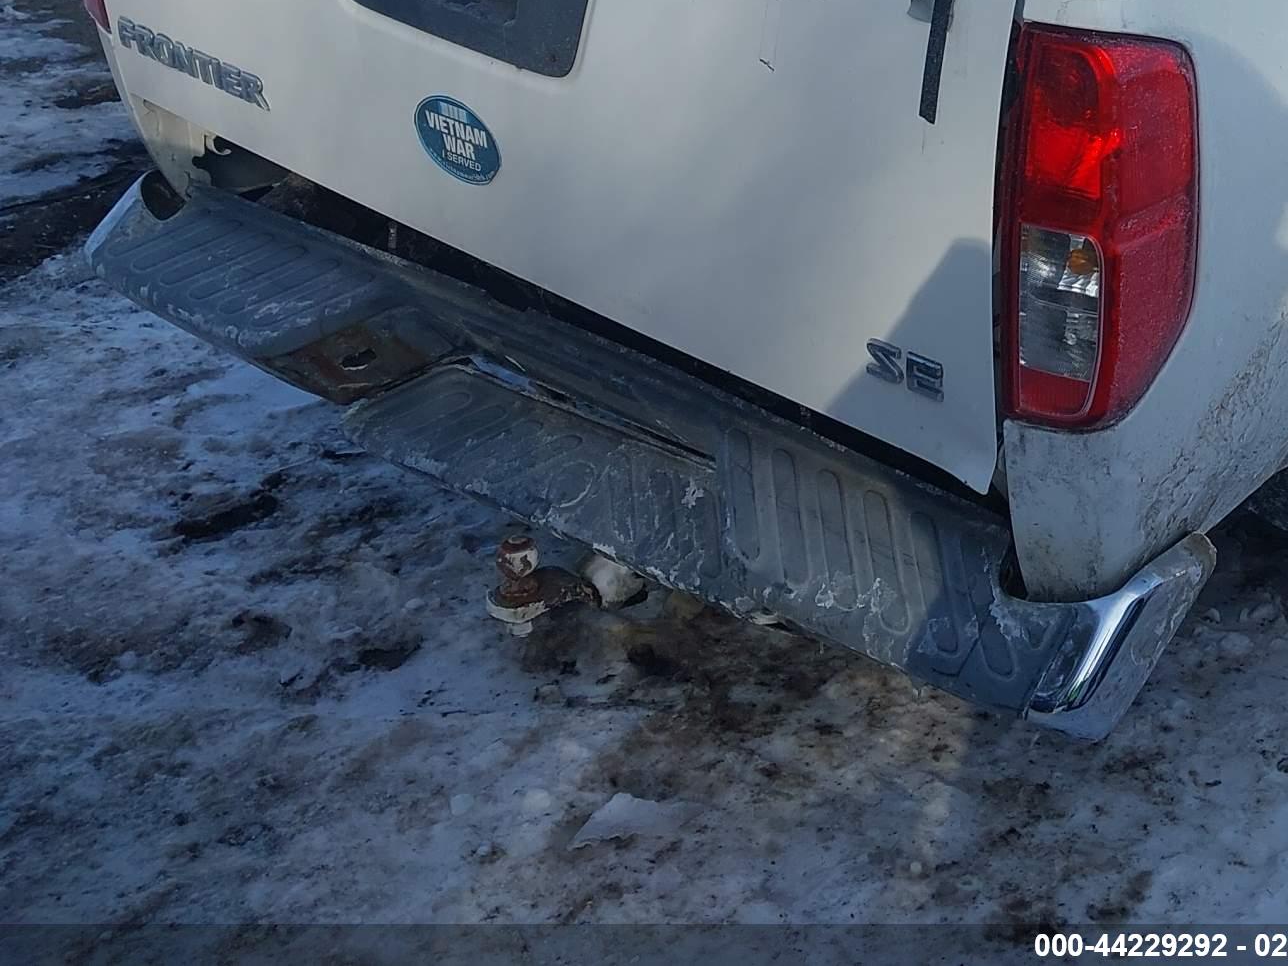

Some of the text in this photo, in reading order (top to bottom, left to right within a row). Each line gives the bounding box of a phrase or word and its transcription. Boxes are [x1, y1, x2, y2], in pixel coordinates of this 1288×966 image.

[118, 15, 270, 112] FRONTIER
[425, 110, 488, 149] VIETNAM
[442, 133, 476, 160] WAR
[447, 151, 481, 171] SERVED
[866, 337, 944, 403] SE
